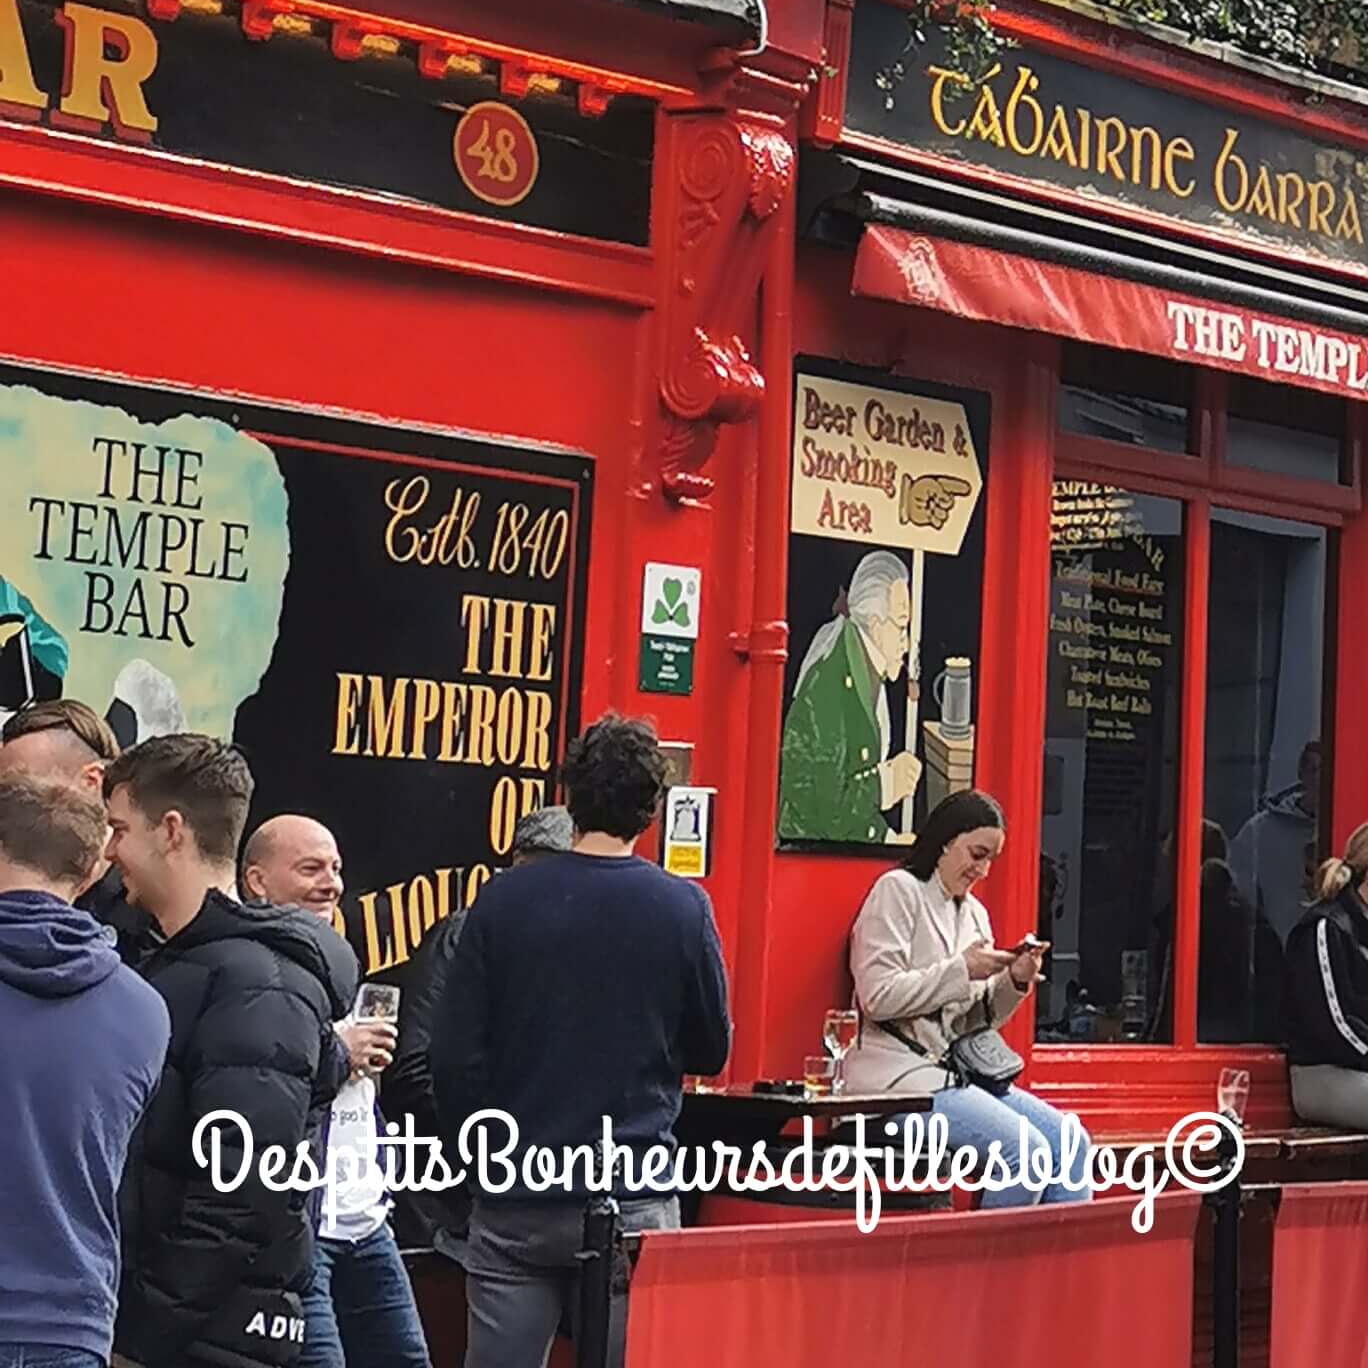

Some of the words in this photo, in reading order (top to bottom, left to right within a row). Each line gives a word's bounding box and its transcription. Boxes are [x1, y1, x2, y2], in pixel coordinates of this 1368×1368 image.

[466, 119, 518, 184] 48
[1167, 299, 1248, 363] THE
[803, 387, 856, 437] Beer
[864, 402, 947, 455] Garden
[93, 435, 205, 509] THE
[801, 438, 898, 499] Smoking
[29, 496, 250, 584] TEMPLE
[487, 500, 570, 580] 1840
[817, 489, 873, 534] Area
[80, 570, 195, 648] BAR
[461, 593, 556, 681] THE
[332, 671, 555, 771] EMPEROR
